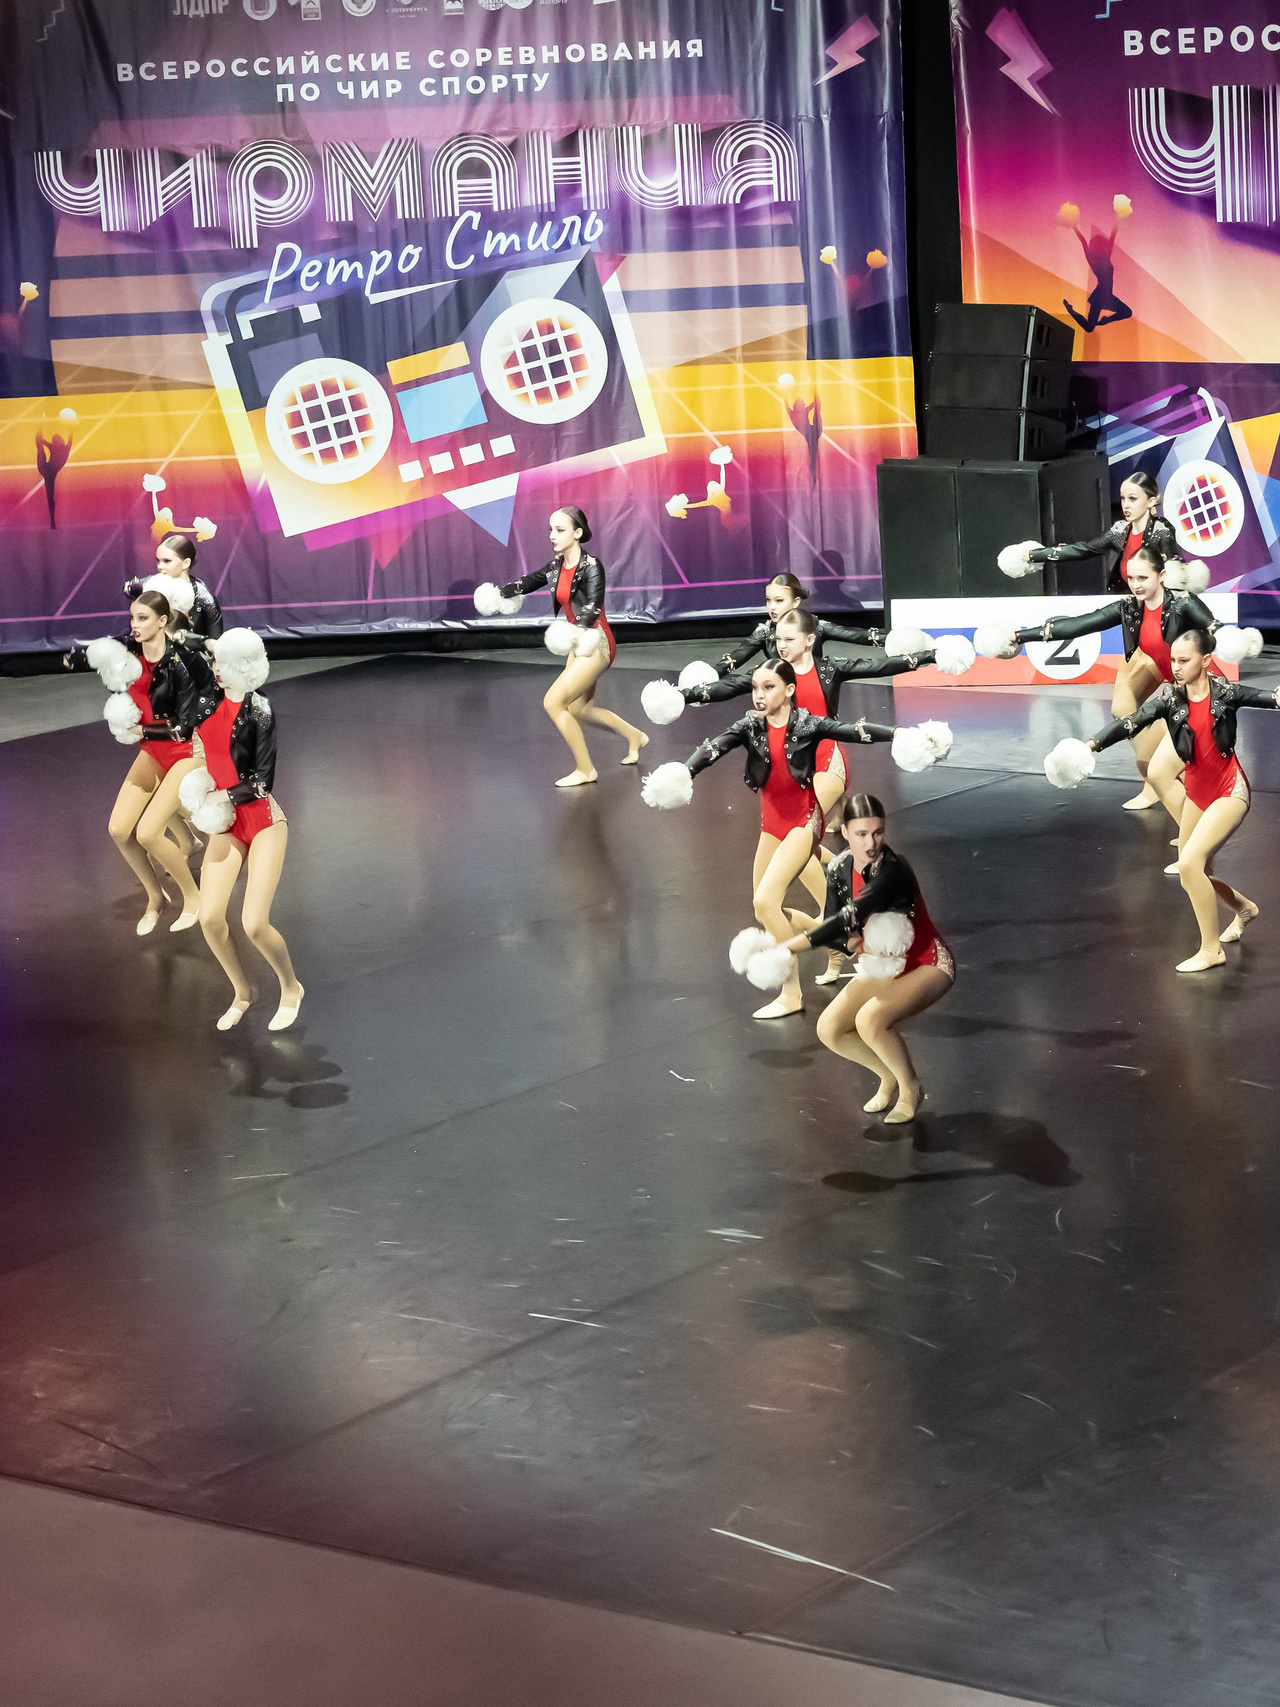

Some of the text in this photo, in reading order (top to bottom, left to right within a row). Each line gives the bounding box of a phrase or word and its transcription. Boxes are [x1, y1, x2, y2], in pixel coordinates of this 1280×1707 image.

[116, 39, 704, 82] ВСЕРОССИЙСКИЕ СОРЕВНОВАНИЯ
[276, 72, 550, 103] ПО ЧИР СПОРТУ
[263, 210, 604, 304] Ретро Стиль
